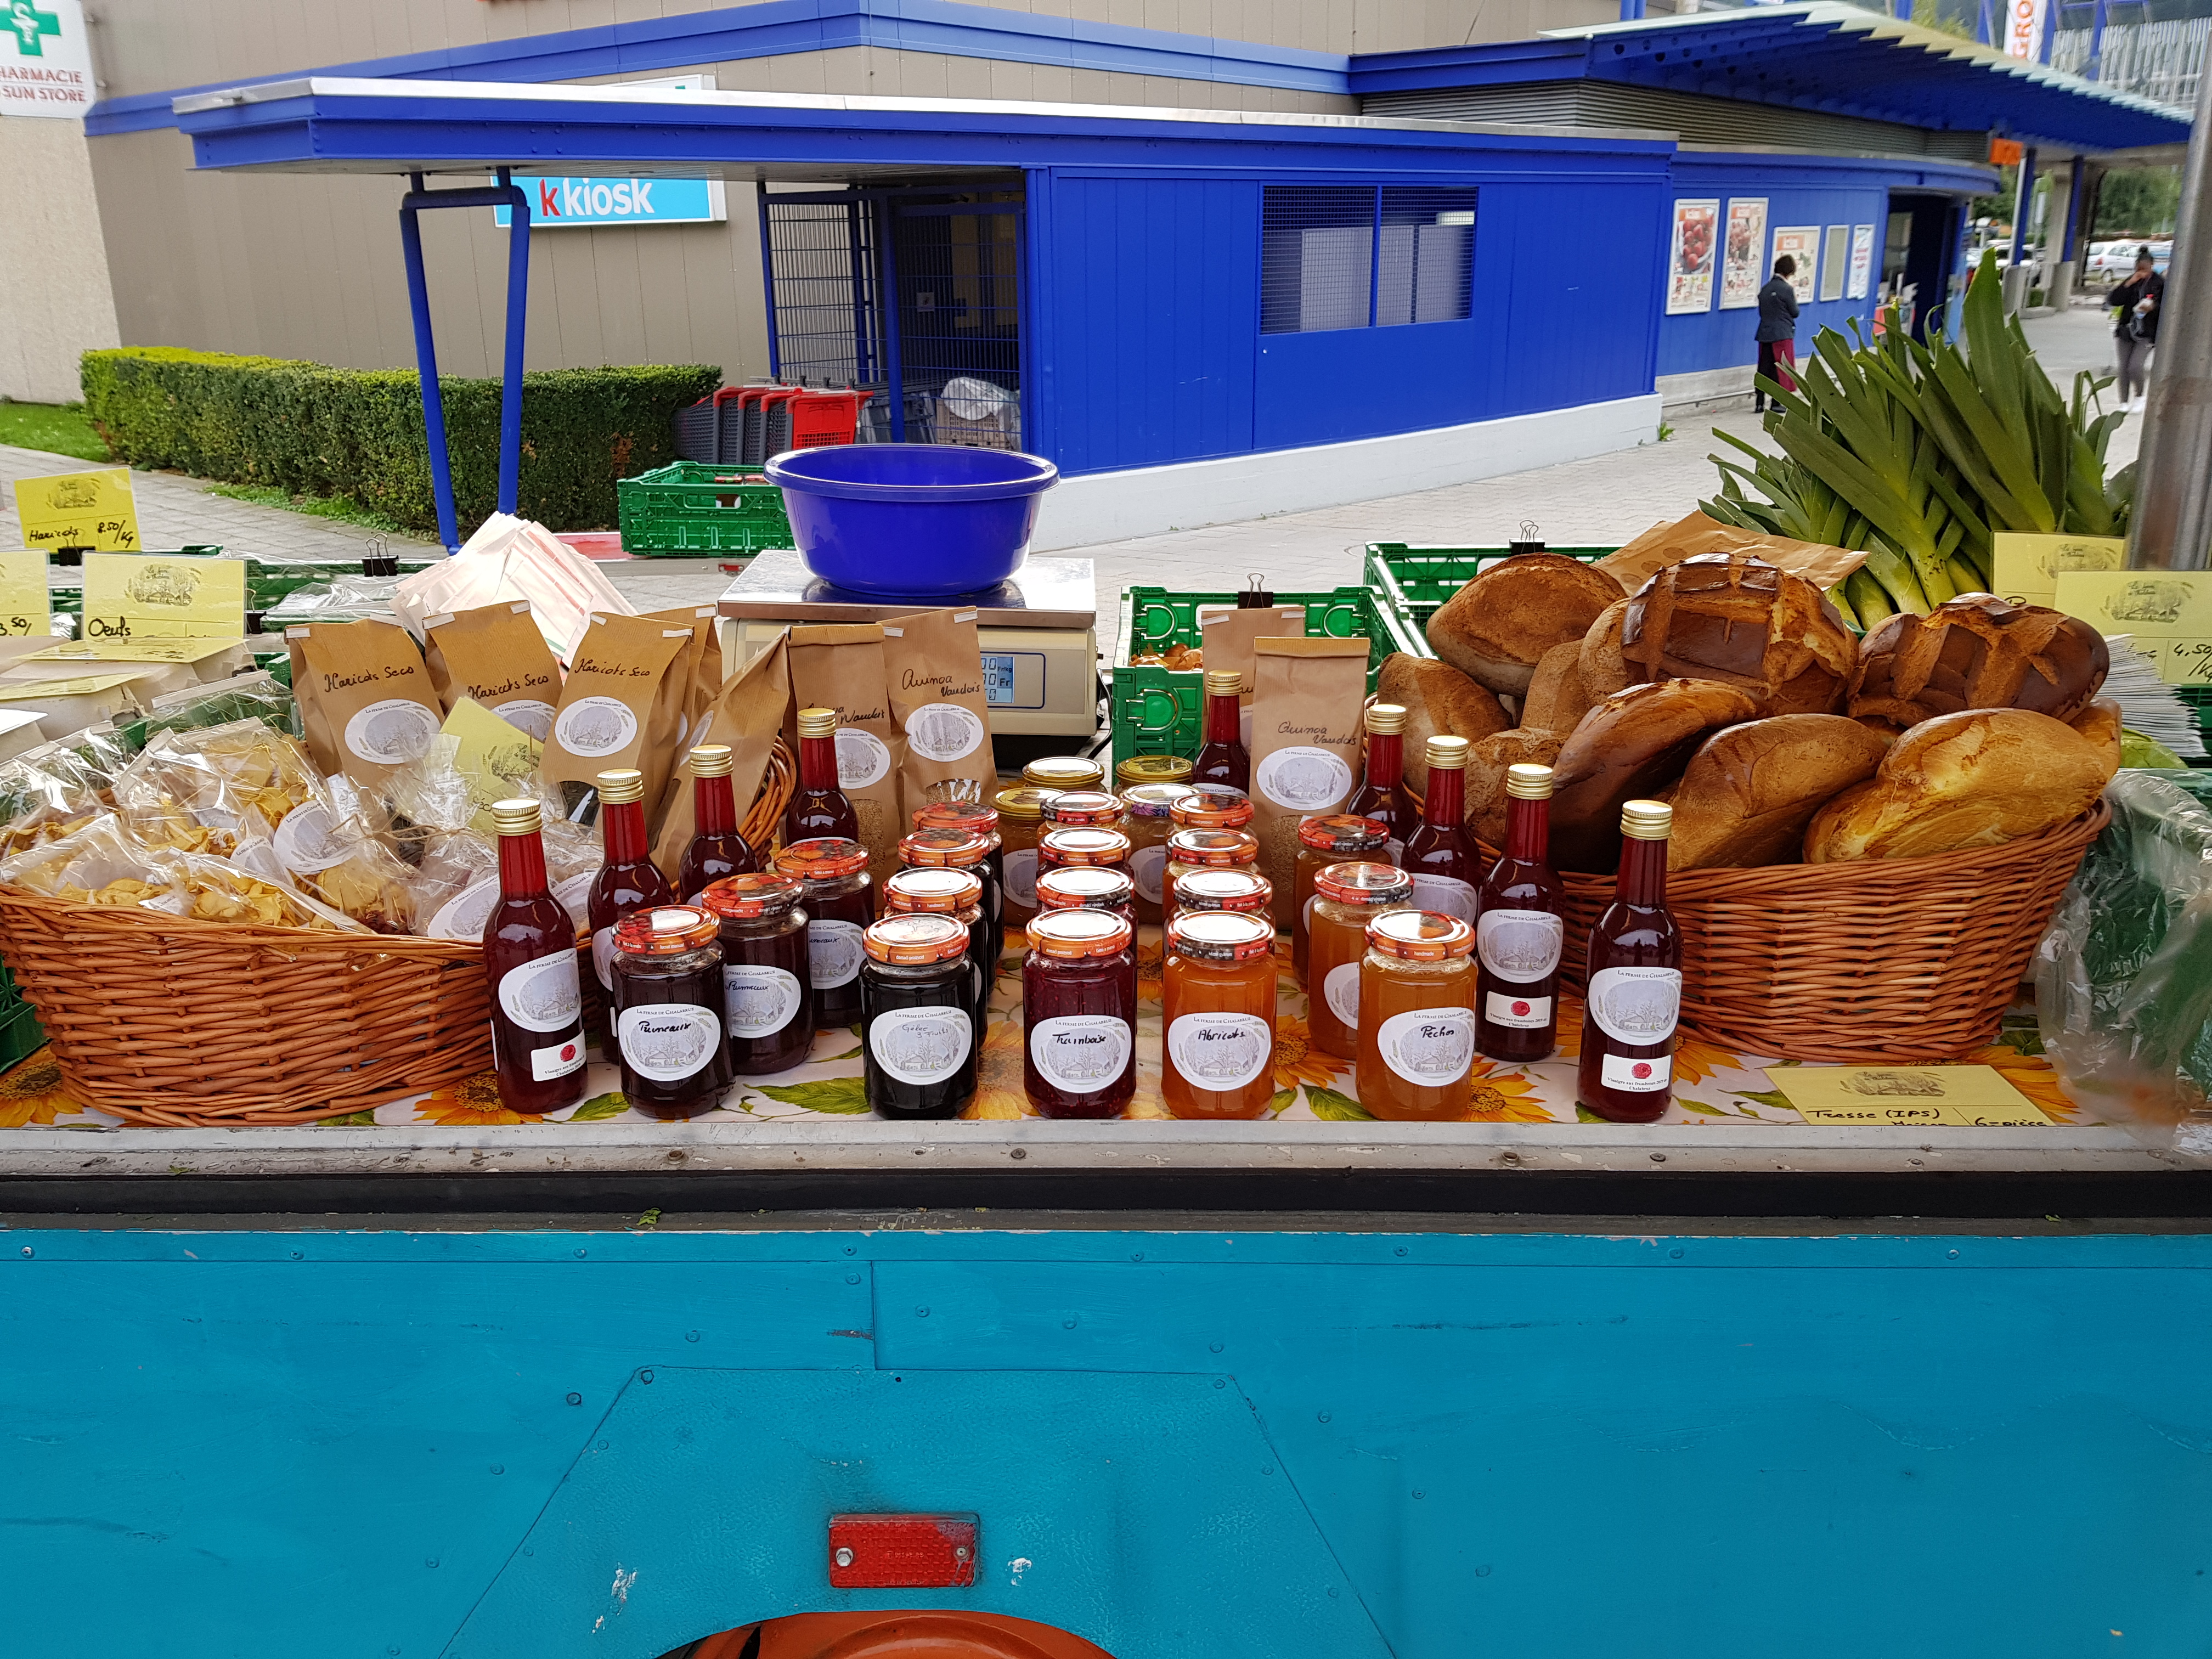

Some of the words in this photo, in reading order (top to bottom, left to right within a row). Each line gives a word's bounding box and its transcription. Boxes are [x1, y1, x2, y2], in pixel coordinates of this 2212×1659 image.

[3, 86, 35, 100] SUN
[38, 88, 86, 102] STORE
[574, 658, 627, 676] Haricots
[324, 669, 379, 693] Haricots
[902, 669, 952, 690] Quinoa
[1000, 678, 1010, 686] Fr
[468, 679, 520, 699] Haricots
[1278, 721, 1327, 734] Quinoa
